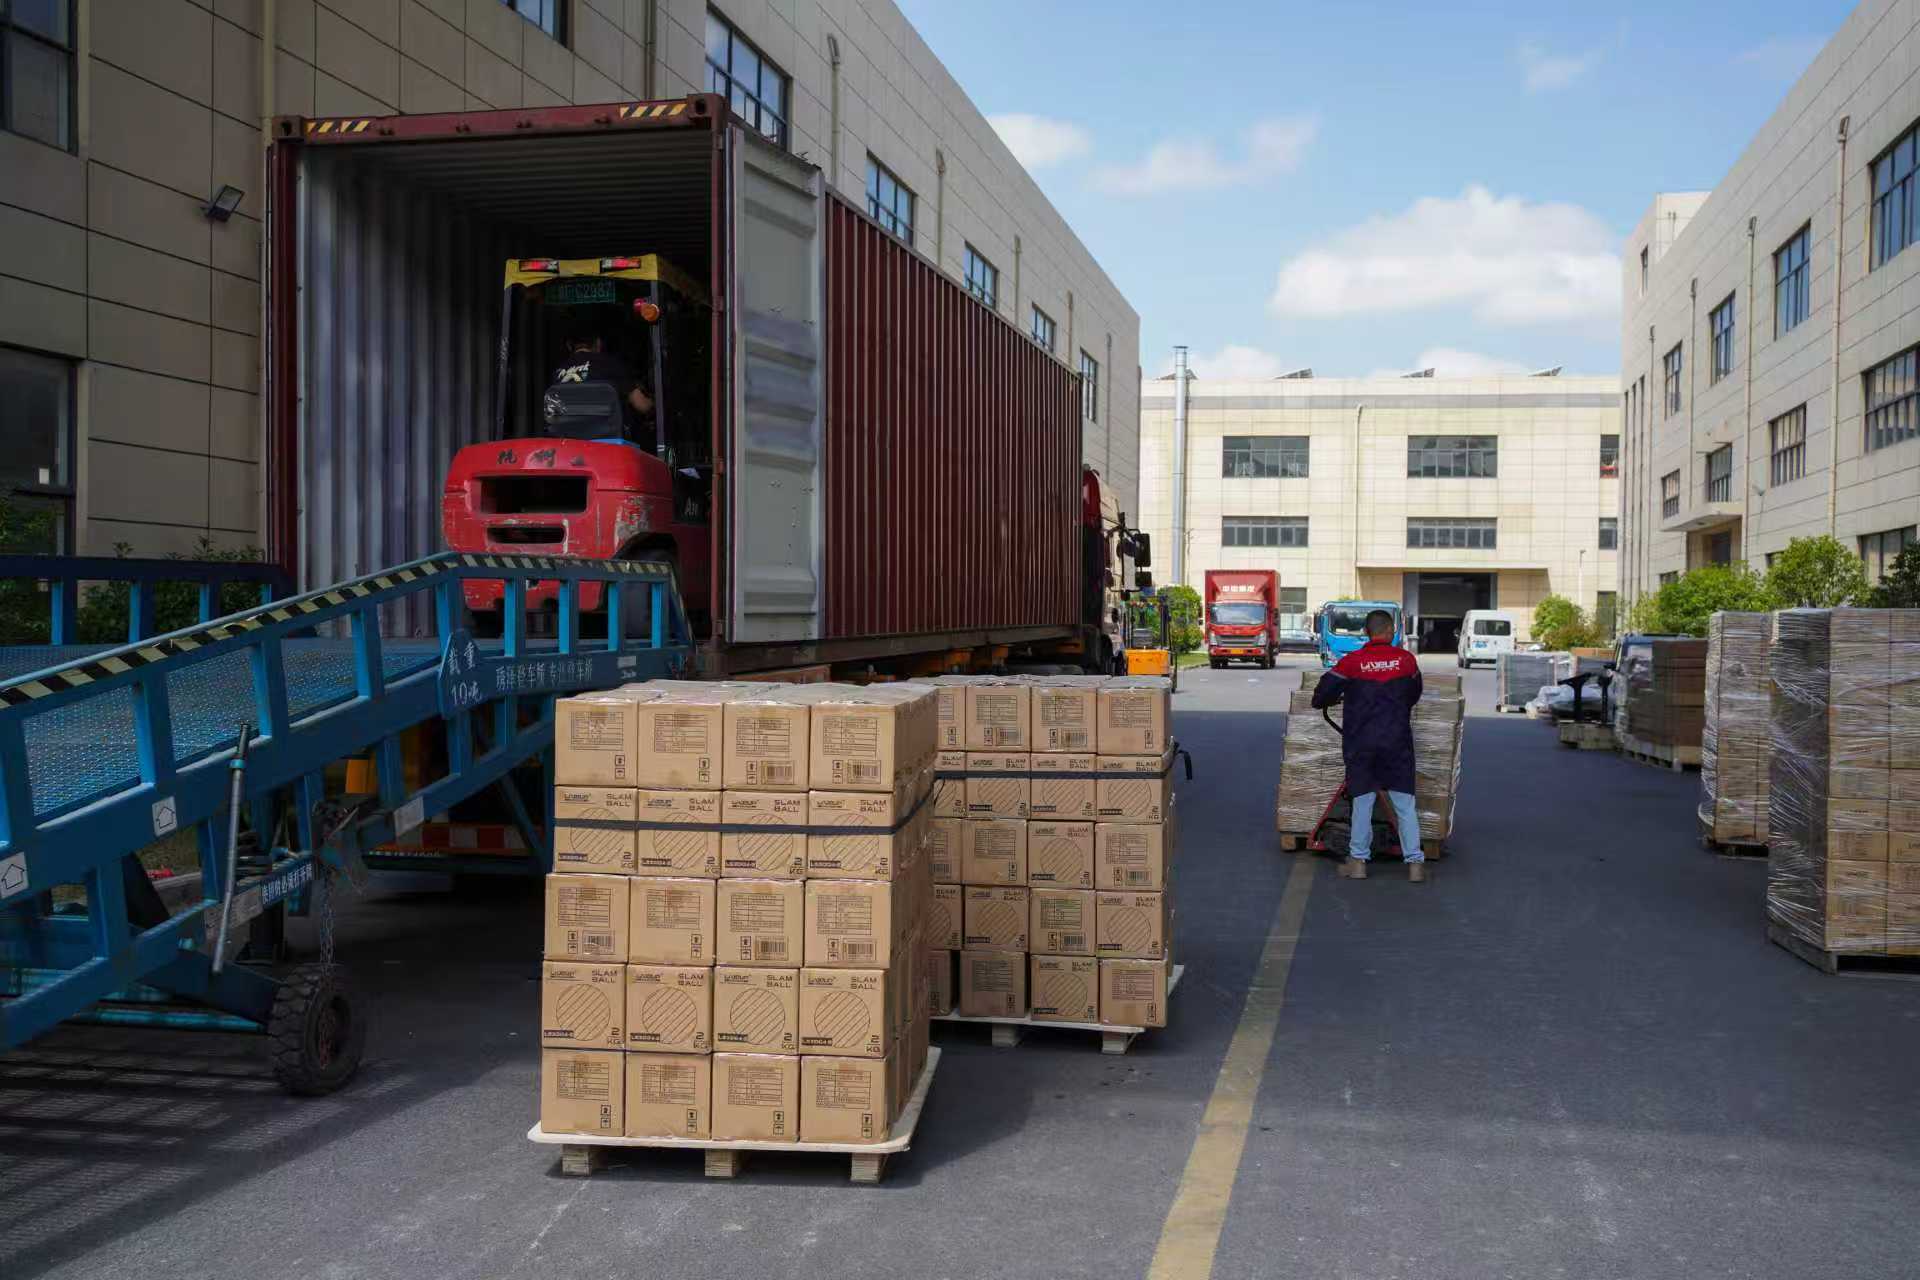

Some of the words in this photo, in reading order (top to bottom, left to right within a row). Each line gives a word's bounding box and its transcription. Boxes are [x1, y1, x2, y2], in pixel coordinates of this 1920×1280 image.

[624, 852, 632, 860] 2
[706, 856, 715, 864] 2
[794, 857, 802, 865] 2
[880, 857, 888, 865] 2
[875, 867, 888, 875] KG
[696, 1032, 704, 1040] 2
[784, 1033, 792, 1041] 2
[871, 1035, 879, 1043] 2
